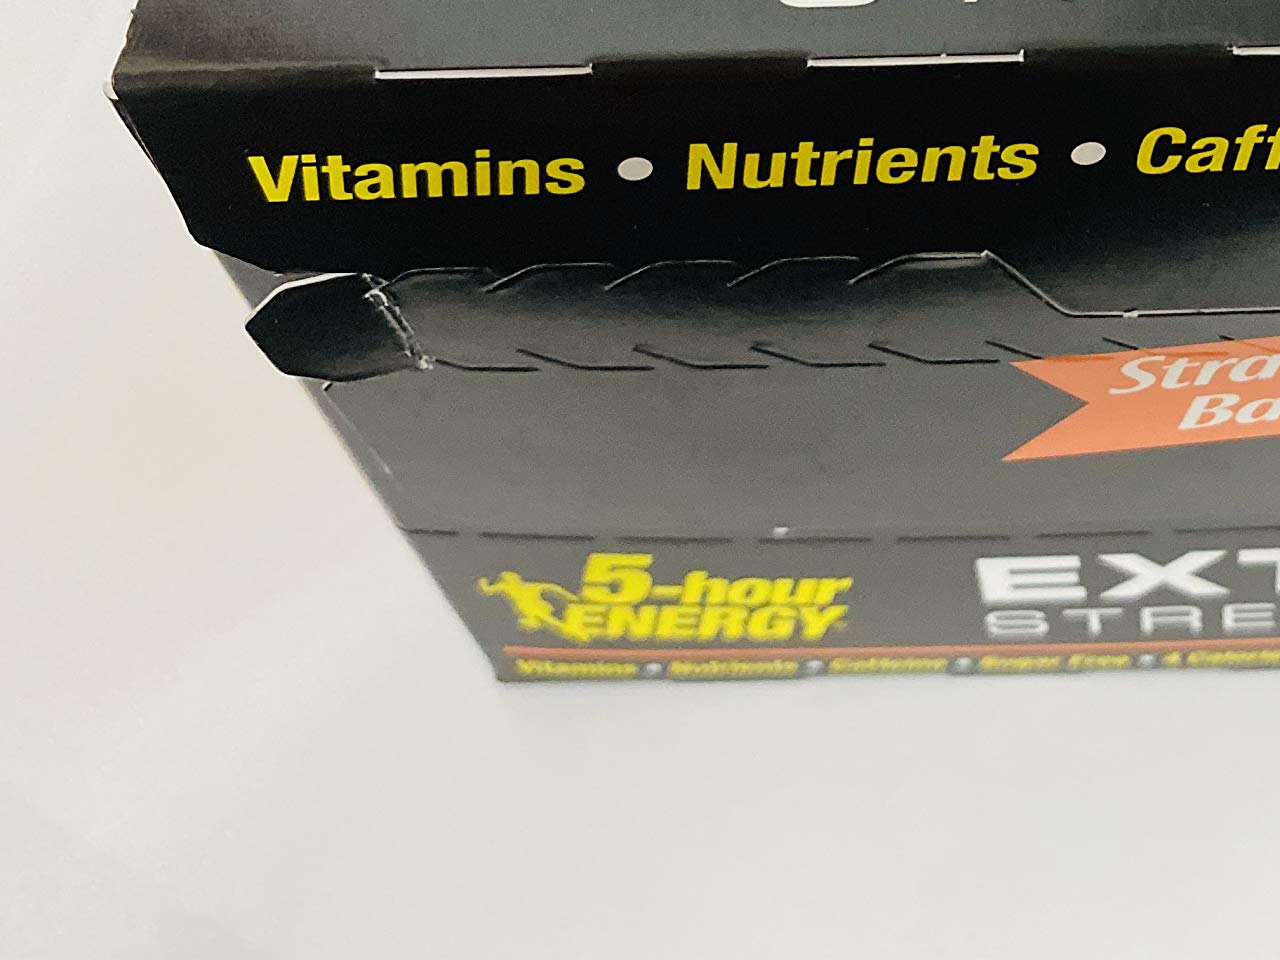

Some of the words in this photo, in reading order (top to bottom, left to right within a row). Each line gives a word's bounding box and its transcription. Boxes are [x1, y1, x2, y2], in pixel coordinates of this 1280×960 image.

[248, 149, 586, 203] Vitamins
[685, 133, 1040, 191] Nutrients
[581, 552, 854, 606] 5-hour
[563, 602, 850, 642] ENERGY
